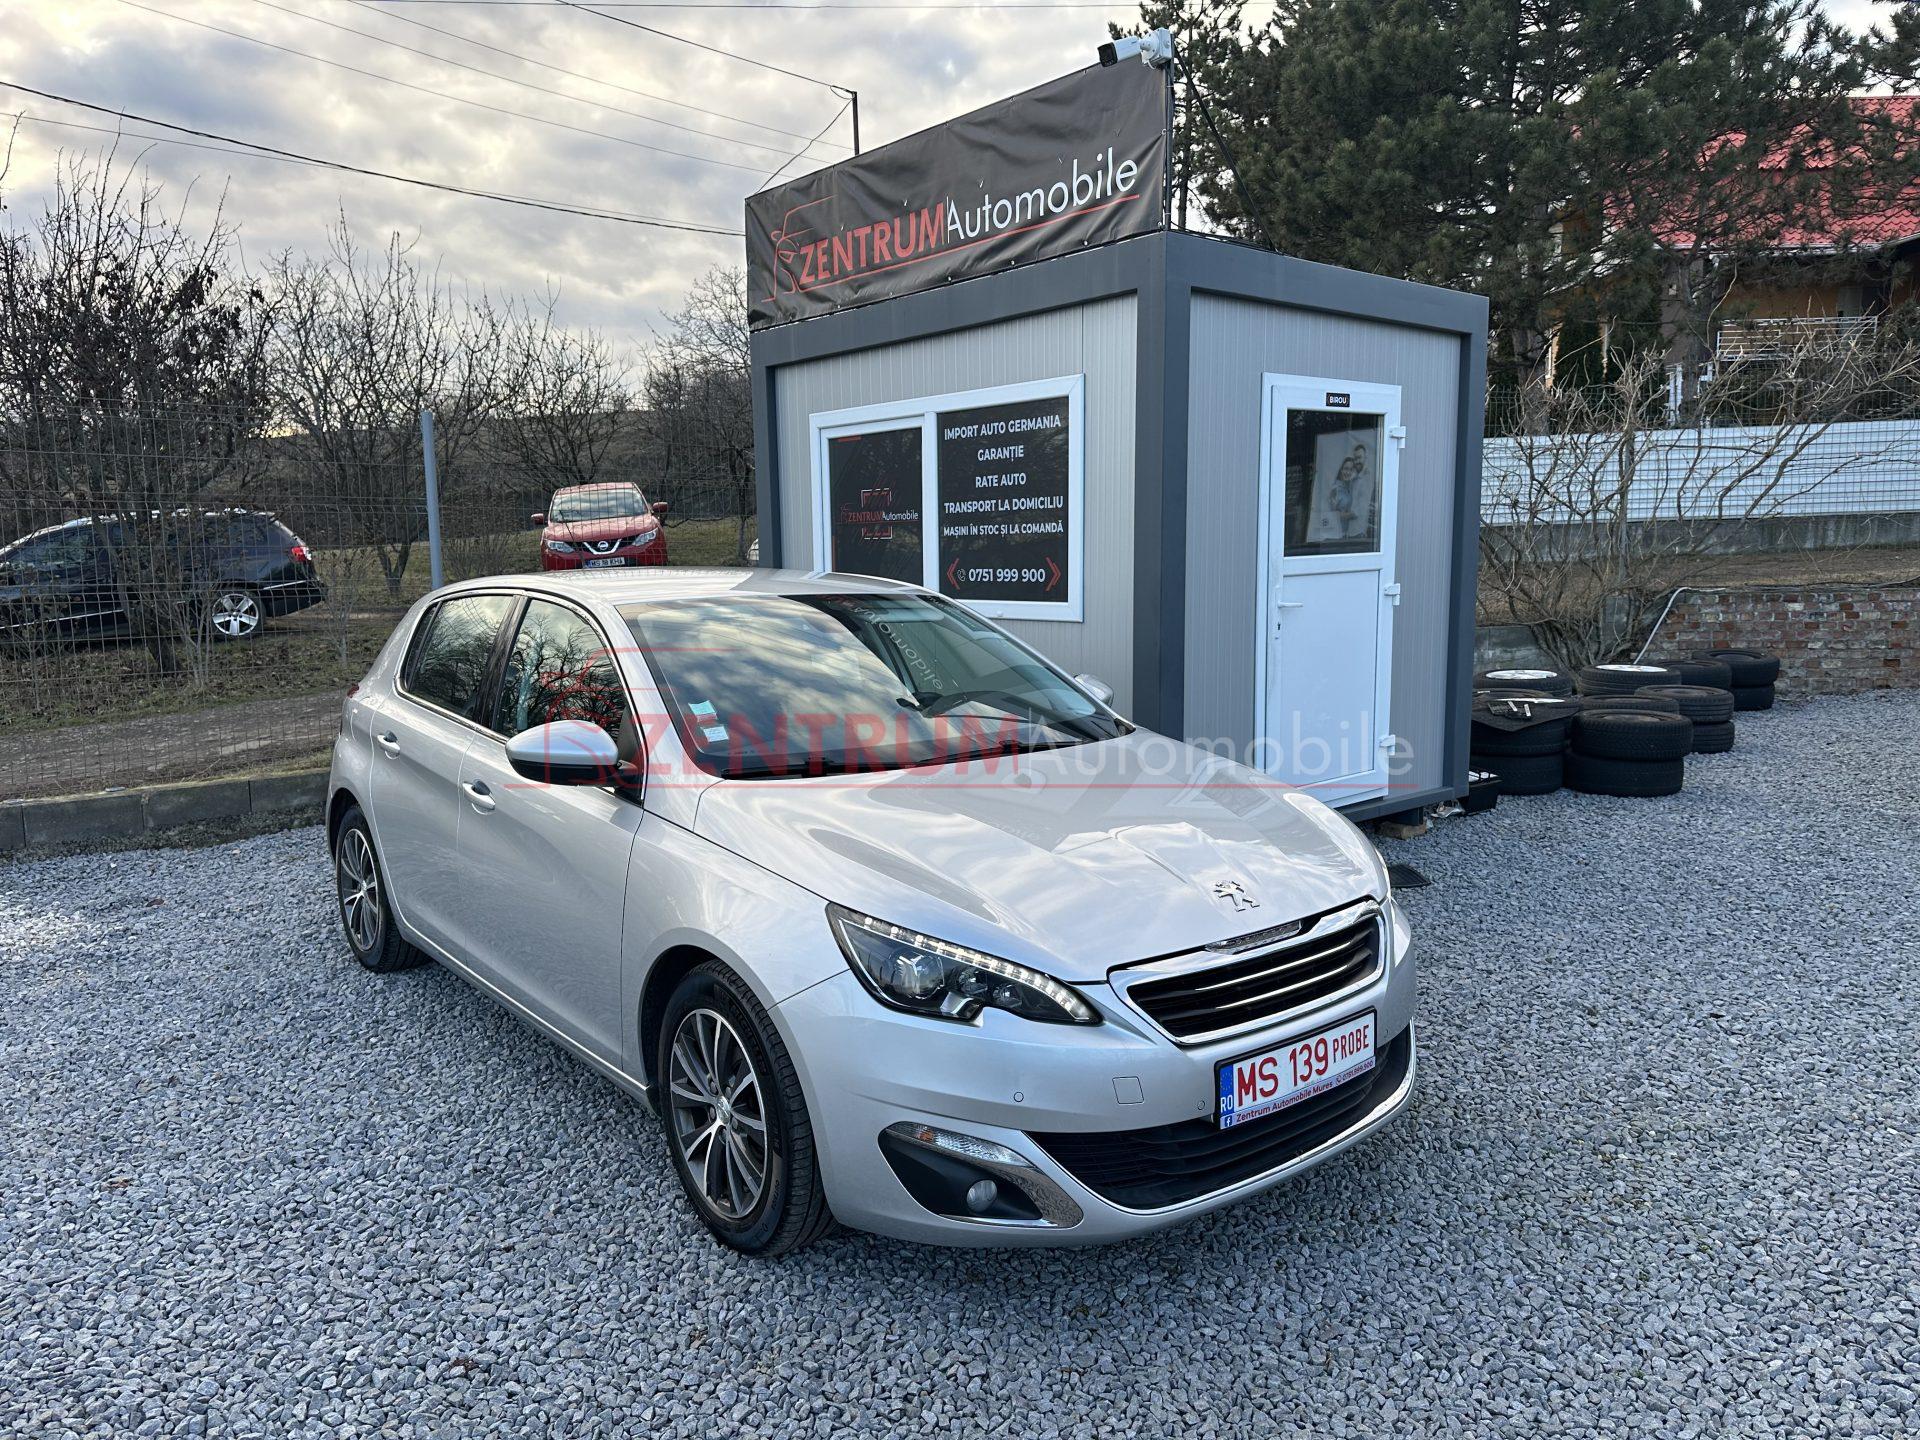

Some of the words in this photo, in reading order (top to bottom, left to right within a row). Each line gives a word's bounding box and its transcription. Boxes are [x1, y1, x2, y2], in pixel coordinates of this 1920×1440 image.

[799, 202, 945, 286] ZENTRUM
[947, 147, 1138, 243] Automobile
[1330, 396, 1347, 404] BIROU
[944, 425, 979, 440] IMPORT
[980, 421, 1006, 437] AUTO
[1008, 414, 1061, 433] GERMANIA
[977, 445, 1025, 462] GARANȚIE
[975, 475, 998, 488] RATE
[1000, 472, 1027, 486] AUTO
[944, 499, 996, 514] TRANSPORT
[998, 499, 1010, 511] LA
[1012, 496, 1063, 510] DOMICILIU
[882, 509, 919, 521] Automobile
[943, 525, 969, 538] MAȘINI
[969, 523, 978, 535] ÎN
[979, 524, 999, 535] STOC
[1000, 524, 1008, 538] ȘI
[1009, 524, 1020, 534] LA
[1021, 520, 1064, 533] COMANDĂ
[968, 568, 993, 582] 0751
[996, 568, 1019, 582] 999
[1021, 568, 1046, 582] 900
[1237, 1056, 1279, 1106] MS
[1289, 1037, 1329, 1087] 139
[1332, 1024, 1370, 1063] PROBE
[1220, 1094, 1233, 1113] RO
[1236, 1105, 1271, 1122] Zentrum
[1272, 1088, 1312, 1110] Automobile
